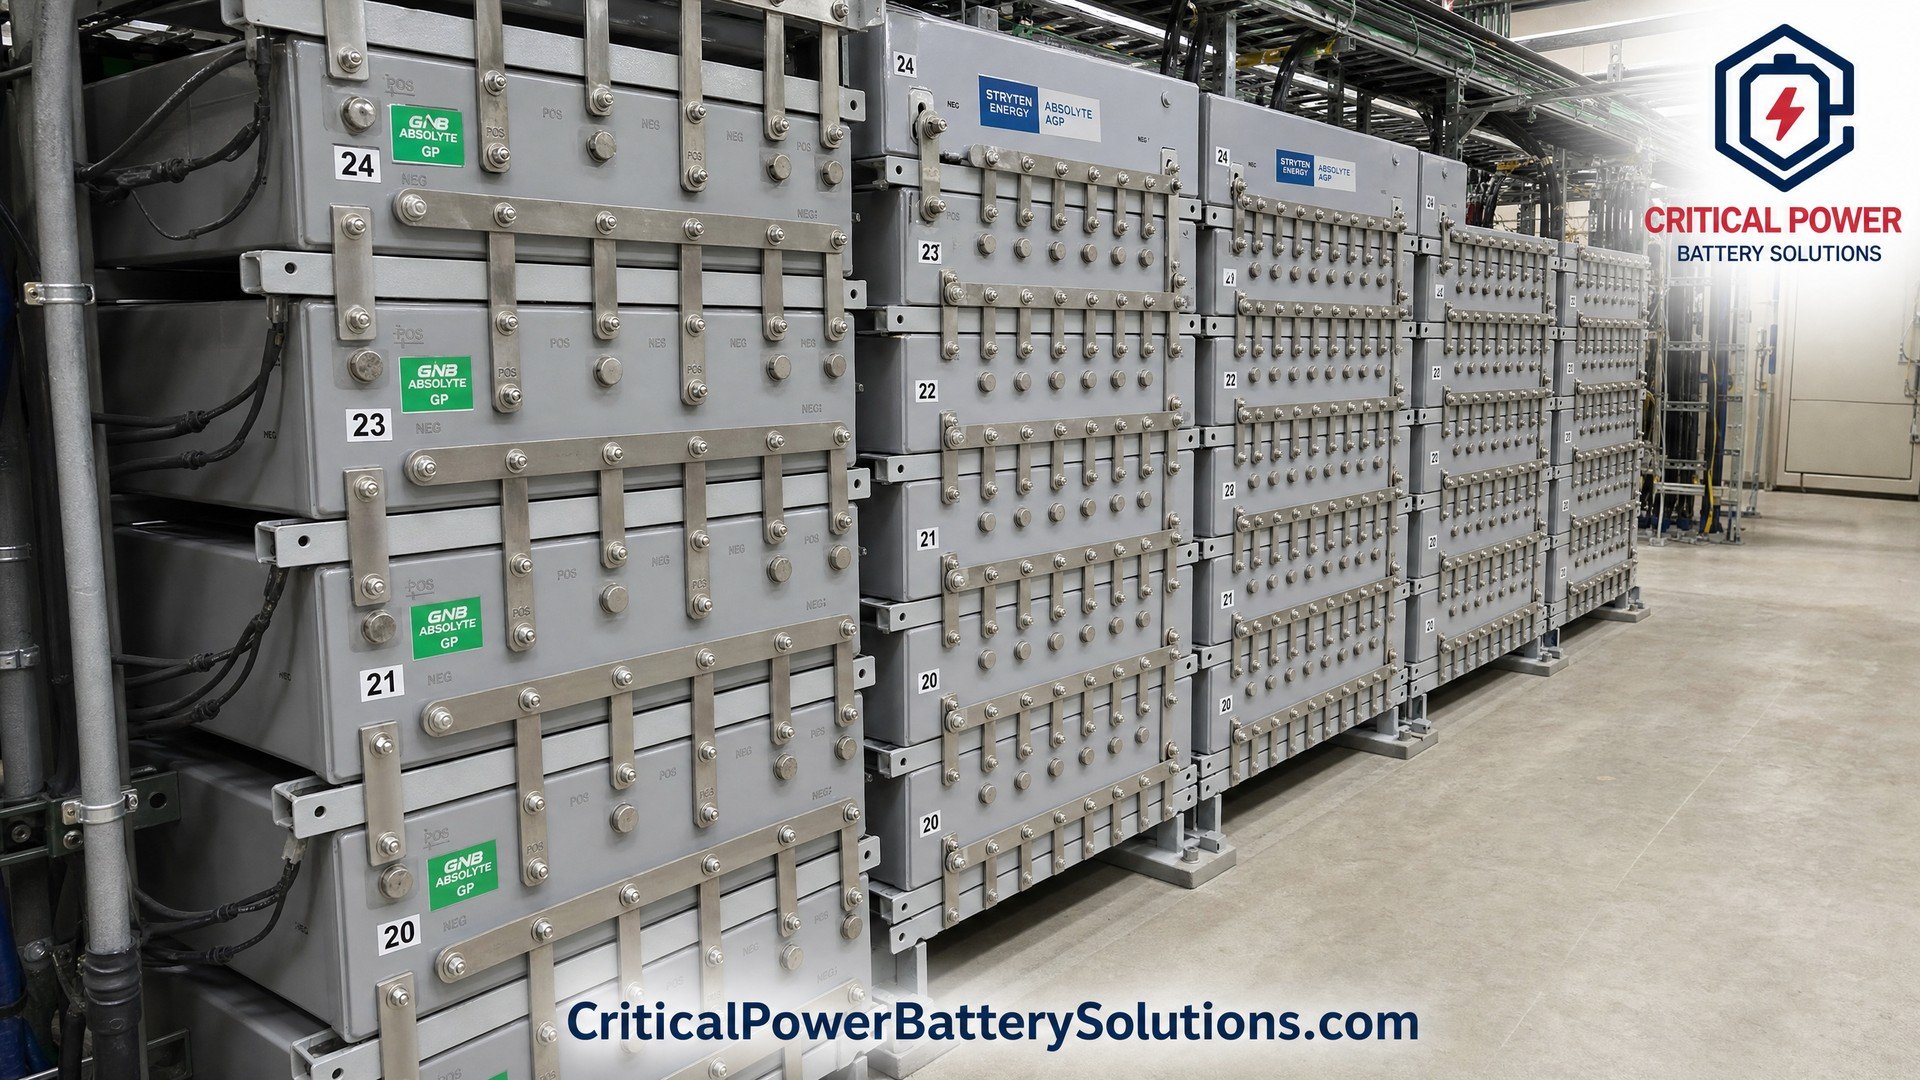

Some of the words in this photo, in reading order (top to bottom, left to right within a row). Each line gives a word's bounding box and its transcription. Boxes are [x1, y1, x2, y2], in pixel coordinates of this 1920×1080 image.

[897, 55, 914, 75] 24
[985, 89, 1033, 108] STRYTEN
[989, 103, 1030, 118] ENERGY
[1044, 102, 1093, 119] ABSOLYTE
[1045, 114, 1065, 127] AGP
[399, 127, 458, 143] ABSOLYTE
[486, 126, 506, 139] POS
[422, 145, 440, 158] GP
[341, 151, 374, 177] 24
[1280, 157, 1311, 169] STRYTEN
[1282, 166, 1309, 177] ENERGY
[1318, 165, 1351, 177] ABSOLYTE
[1318, 173, 1332, 182] AGP
[402, 173, 427, 187] NEG
[922, 243, 940, 261] 23
[550, 337, 570, 349] POS
[417, 363, 458, 377] GNB
[498, 368, 517, 378] POS
[408, 378, 467, 389] ABSOLYTE
[1226, 374, 1236, 386] 22
[919, 383, 936, 399] 22
[430, 394, 449, 405] GP
[352, 412, 386, 437] 23
[416, 422, 441, 435] NEG
[920, 529, 936, 547] 21
[557, 568, 577, 581] POS
[1223, 592, 1232, 606] 21
[428, 605, 468, 624] GNB
[513, 605, 531, 618] POS
[419, 618, 476, 637] ABSOLYTE
[440, 636, 459, 649] GP
[367, 670, 395, 696] 21
[427, 671, 453, 686] NEG
[921, 672, 938, 690] 20
[1221, 698, 1231, 712] 20
[659, 767, 677, 780] POS
[569, 791, 590, 807] POS
[923, 814, 939, 833] 20
[526, 841, 544, 855] POS
[444, 850, 484, 874] GNB
[435, 862, 492, 888] ABSOLYTE
[457, 882, 475, 897] GP
[442, 915, 467, 932] NEG
[384, 920, 415, 950] 20
